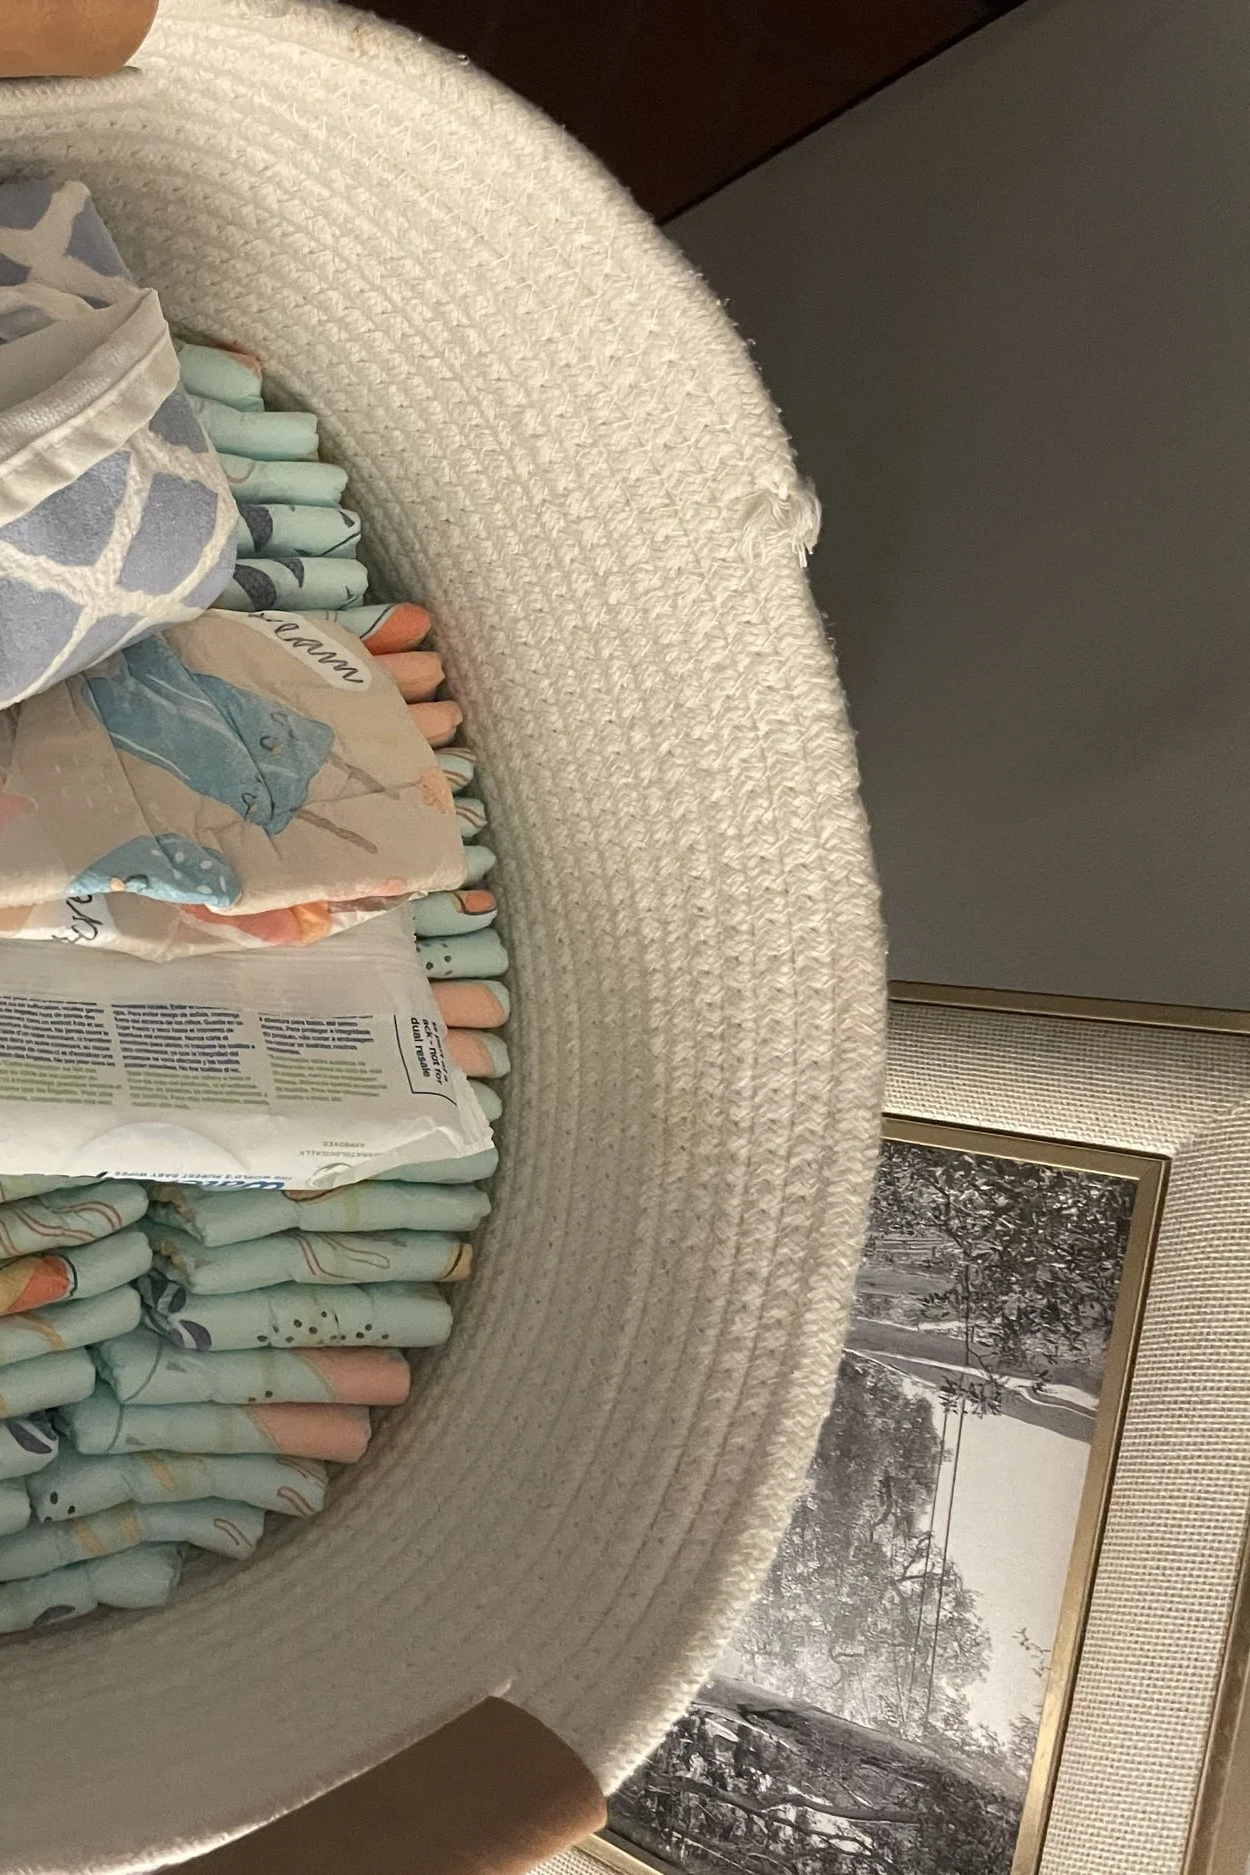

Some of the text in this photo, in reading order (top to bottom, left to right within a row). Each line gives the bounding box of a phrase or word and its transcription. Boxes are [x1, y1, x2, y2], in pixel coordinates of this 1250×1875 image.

[414, 1045, 432, 1078] resale
[428, 1046, 440, 1066] not
[434, 1068, 444, 1086] for
